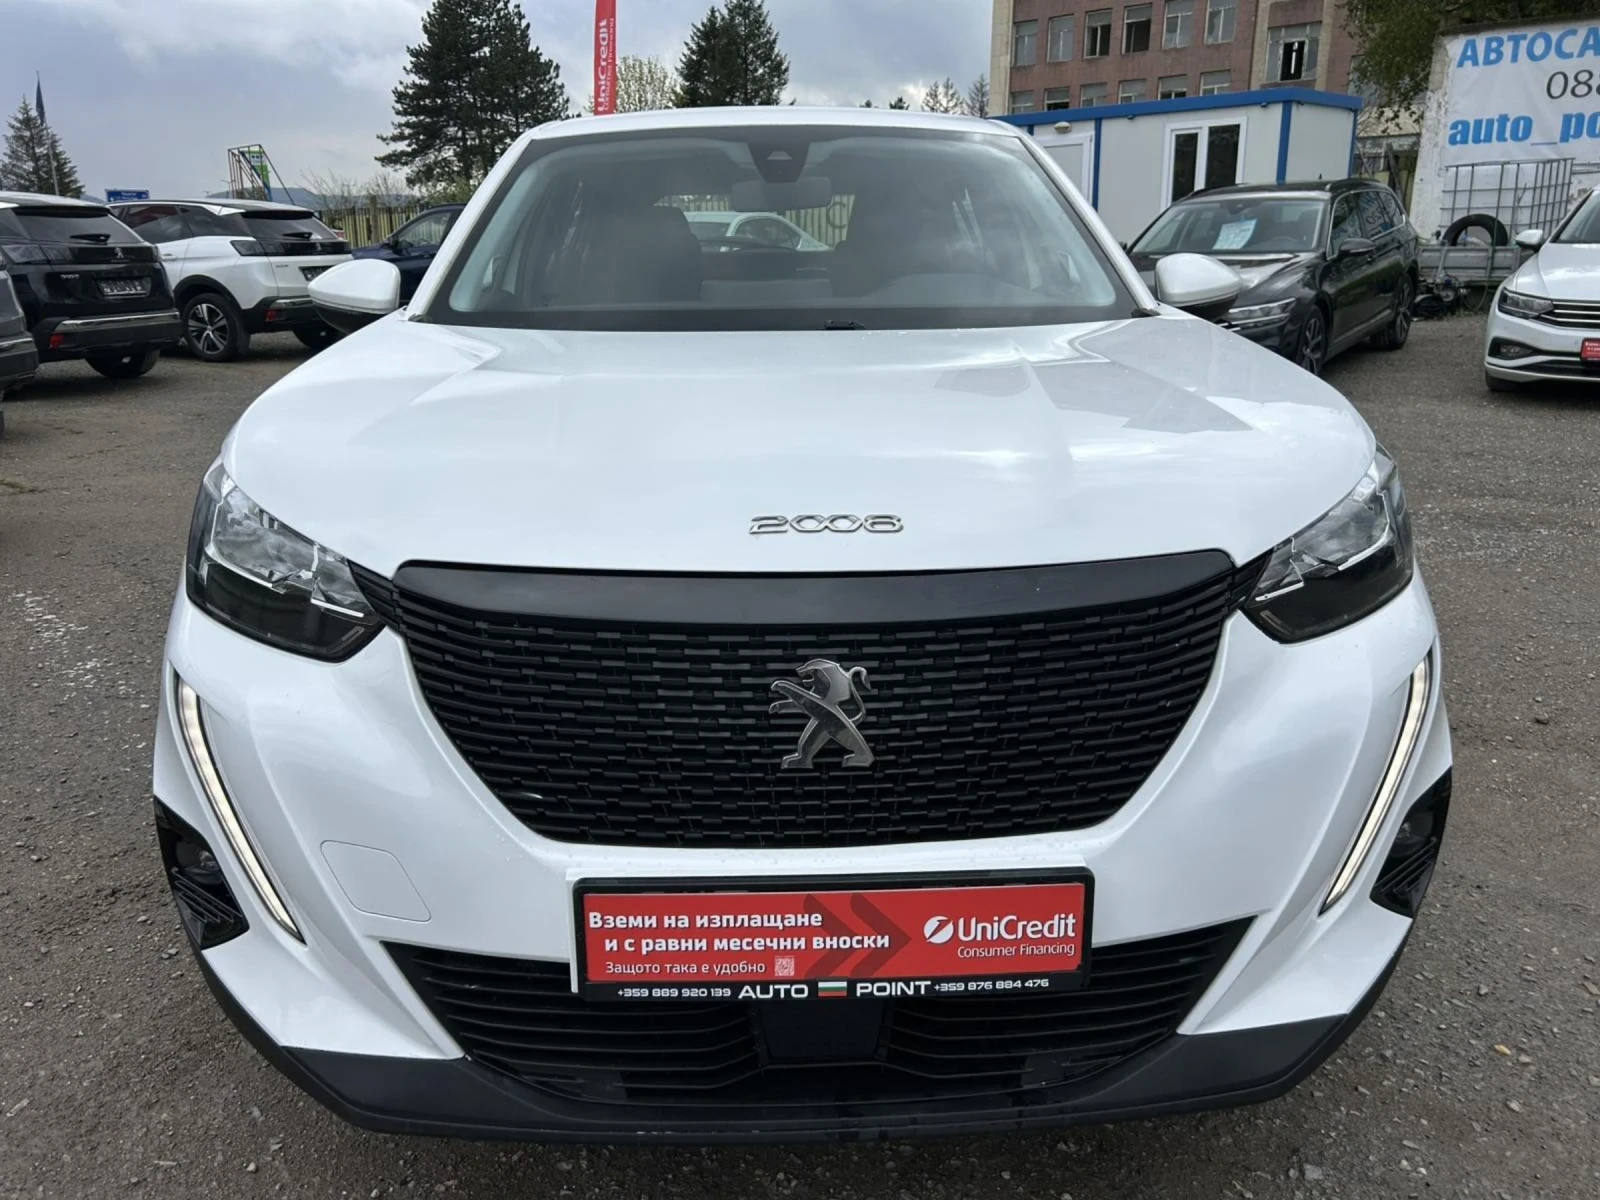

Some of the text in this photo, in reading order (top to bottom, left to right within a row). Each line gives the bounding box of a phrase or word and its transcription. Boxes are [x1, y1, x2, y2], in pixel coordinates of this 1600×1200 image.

[597, 18, 609, 111] UniCredit
[1546, 69, 1600, 99] 08
[749, 514, 904, 534] 2008
[588, 911, 823, 930] Вземи на изплащане
[957, 913, 1076, 942] UniCredit
[604, 934, 890, 955] и с равни месечни вноски
[957, 943, 1075, 958] Consumer Financing
[605, 961, 766, 976] Защото така е удобно
[617, 978, 1049, 999] +359 889 920 139 AUTO POINT +359 876 884 476
